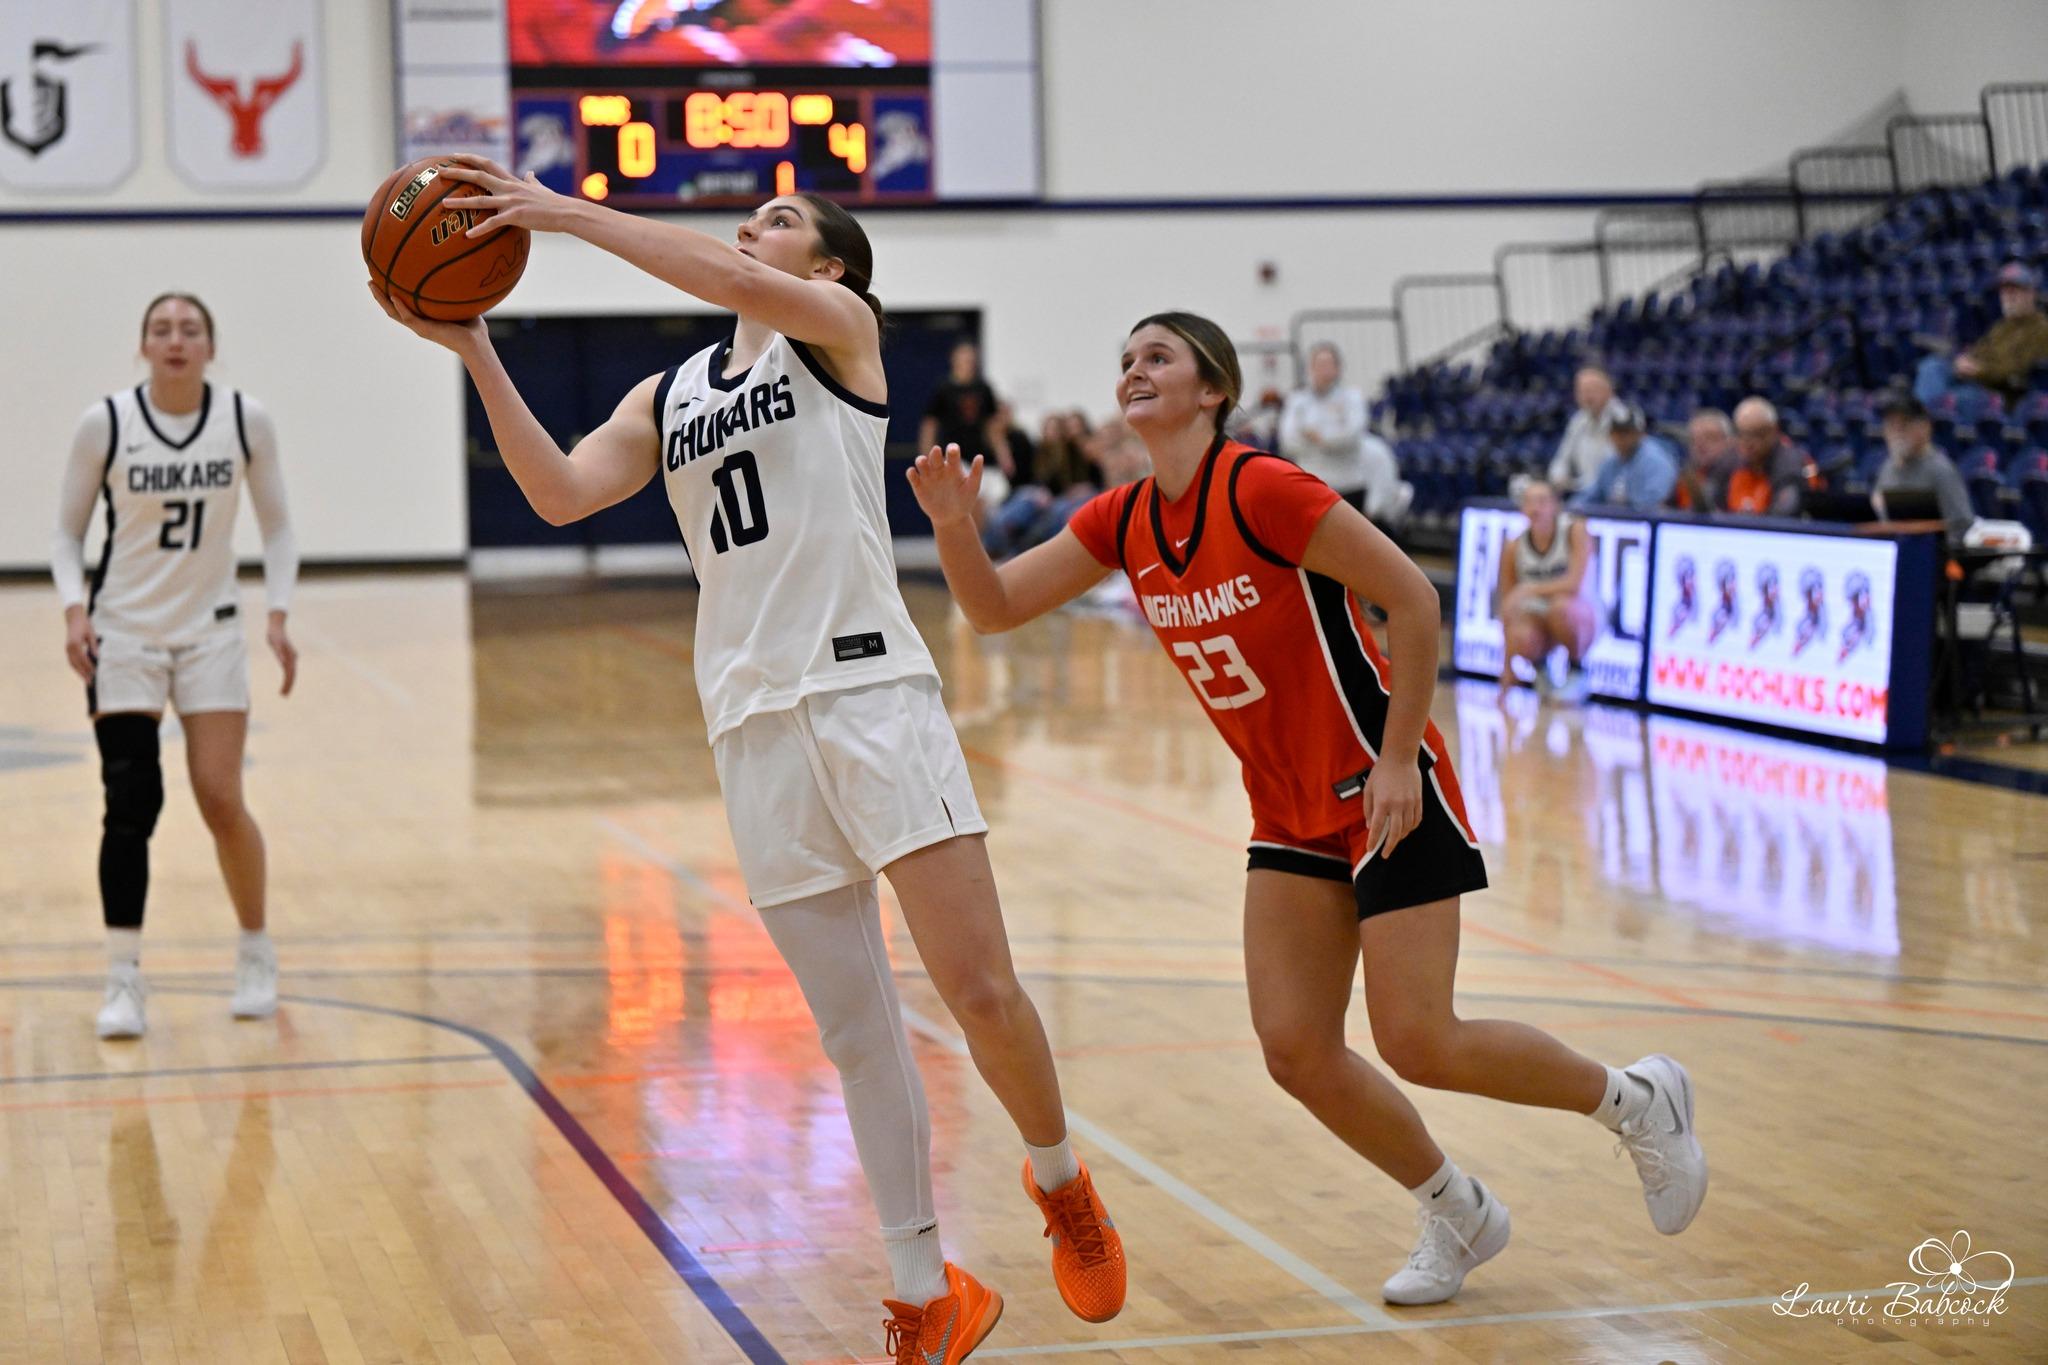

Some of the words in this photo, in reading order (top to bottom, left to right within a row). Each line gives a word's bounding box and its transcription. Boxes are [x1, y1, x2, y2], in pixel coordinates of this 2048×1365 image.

[618, 121, 656, 178] 0
[828, 122, 867, 174] 4
[393, 183, 422, 218] PRO
[431, 208, 480, 246] den
[667, 374, 796, 473] CHUKARS
[128, 459, 234, 493] CHUKARS
[159, 500, 205, 551] 21
[710, 449, 770, 555] 10
[868, 639, 878, 649] M
[1172, 634, 1266, 710] 23
